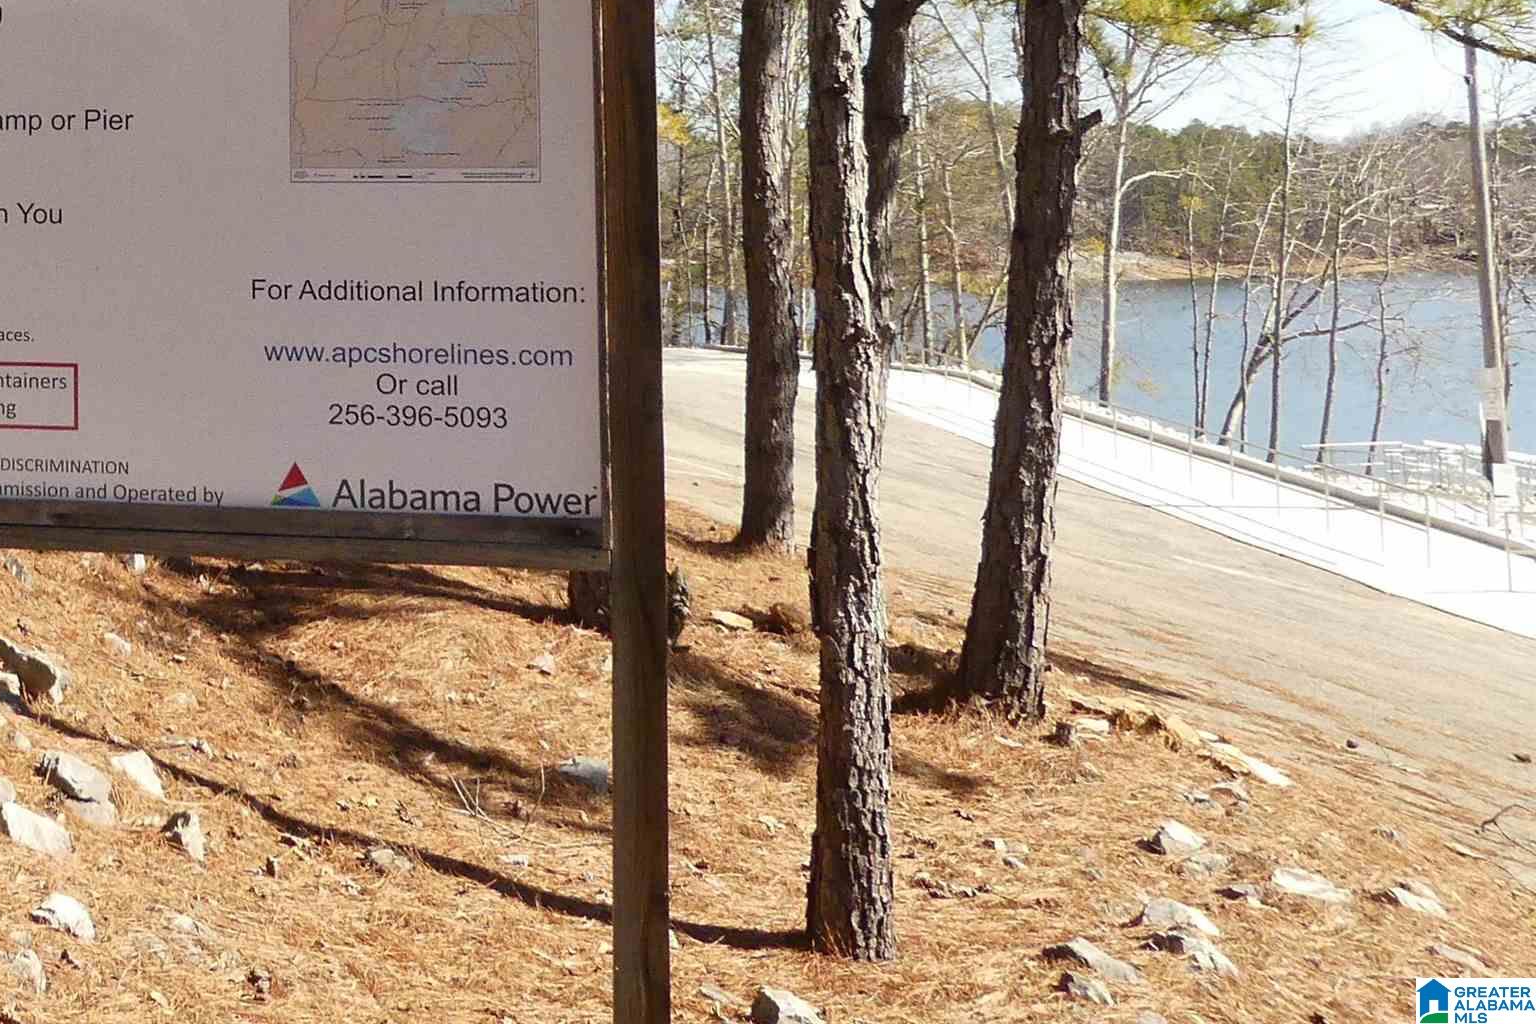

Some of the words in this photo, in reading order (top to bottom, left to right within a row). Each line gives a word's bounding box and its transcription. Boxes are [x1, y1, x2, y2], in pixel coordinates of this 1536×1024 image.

[51, 114, 76, 130] or
[85, 109, 134, 130] Pier
[16, 202, 62, 224] You
[252, 279, 293, 300] For
[299, 280, 422, 302] Additional
[434, 280, 584, 303] Information:
[264, 342, 572, 368] www.apcshorelines.com
[376, 373, 408, 395] Or
[416, 374, 457, 396] call
[329, 403, 507, 429] 256-396-5093
[1, 458, 128, 475] DISCRIMINATION
[75, 483, 107, 498] and
[114, 484, 196, 502] Operated
[204, 486, 224, 507] by
[334, 478, 480, 511] Alabama
[493, 483, 595, 516] Power
